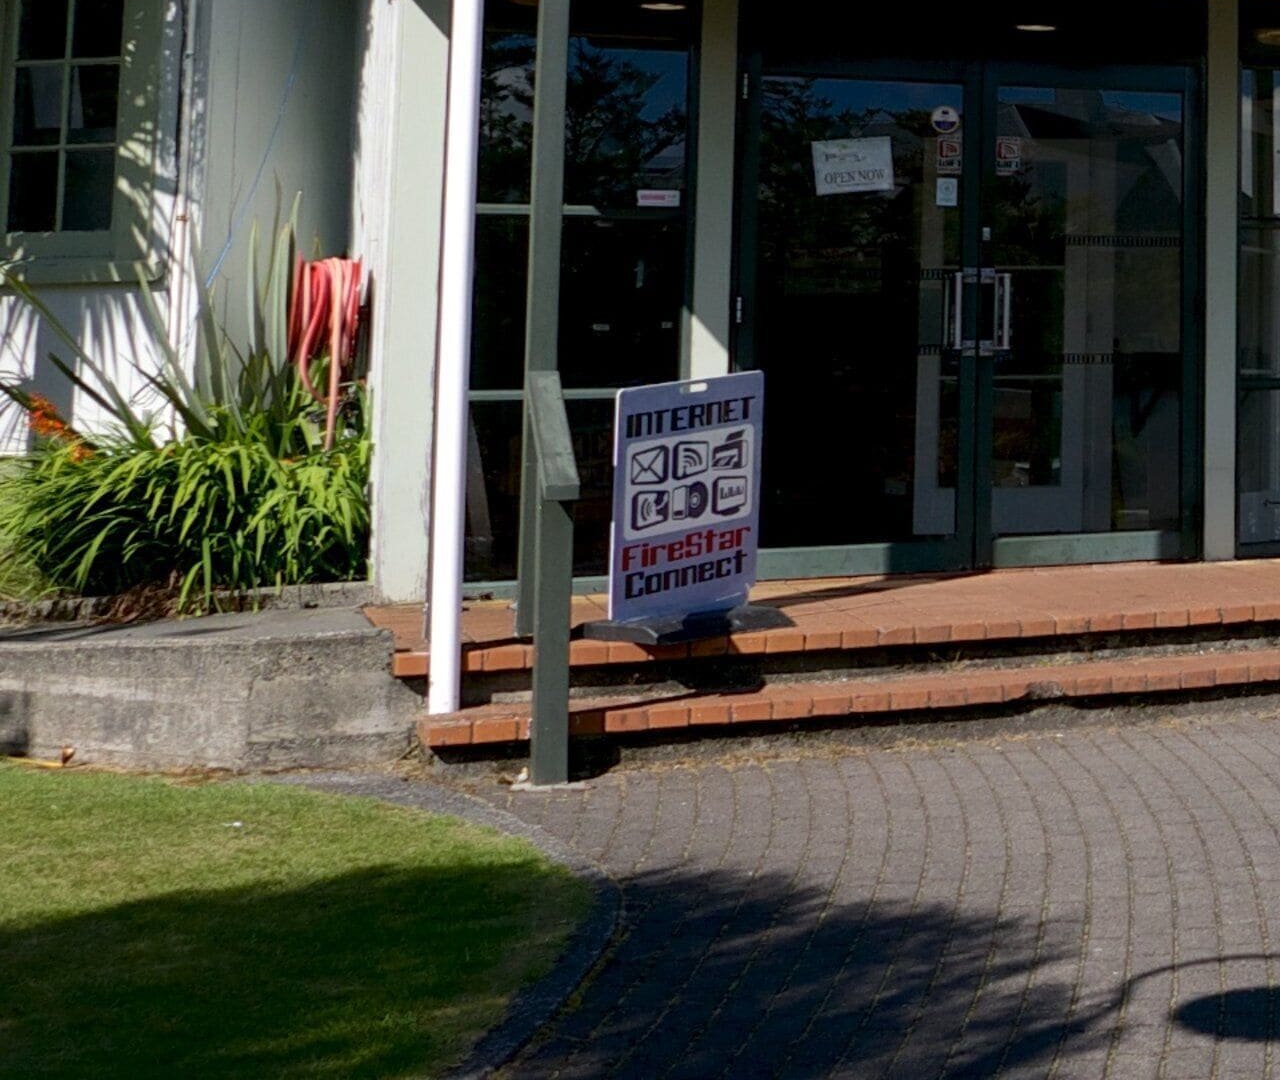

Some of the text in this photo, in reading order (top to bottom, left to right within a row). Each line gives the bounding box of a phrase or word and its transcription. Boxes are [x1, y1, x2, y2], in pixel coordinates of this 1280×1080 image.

[824, 171, 855, 184] OPEN
[857, 168, 885, 182] NOW
[626, 396, 756, 438] INTERNET
[622, 526, 751, 572] FireStar
[625, 549, 748, 600] Connect
